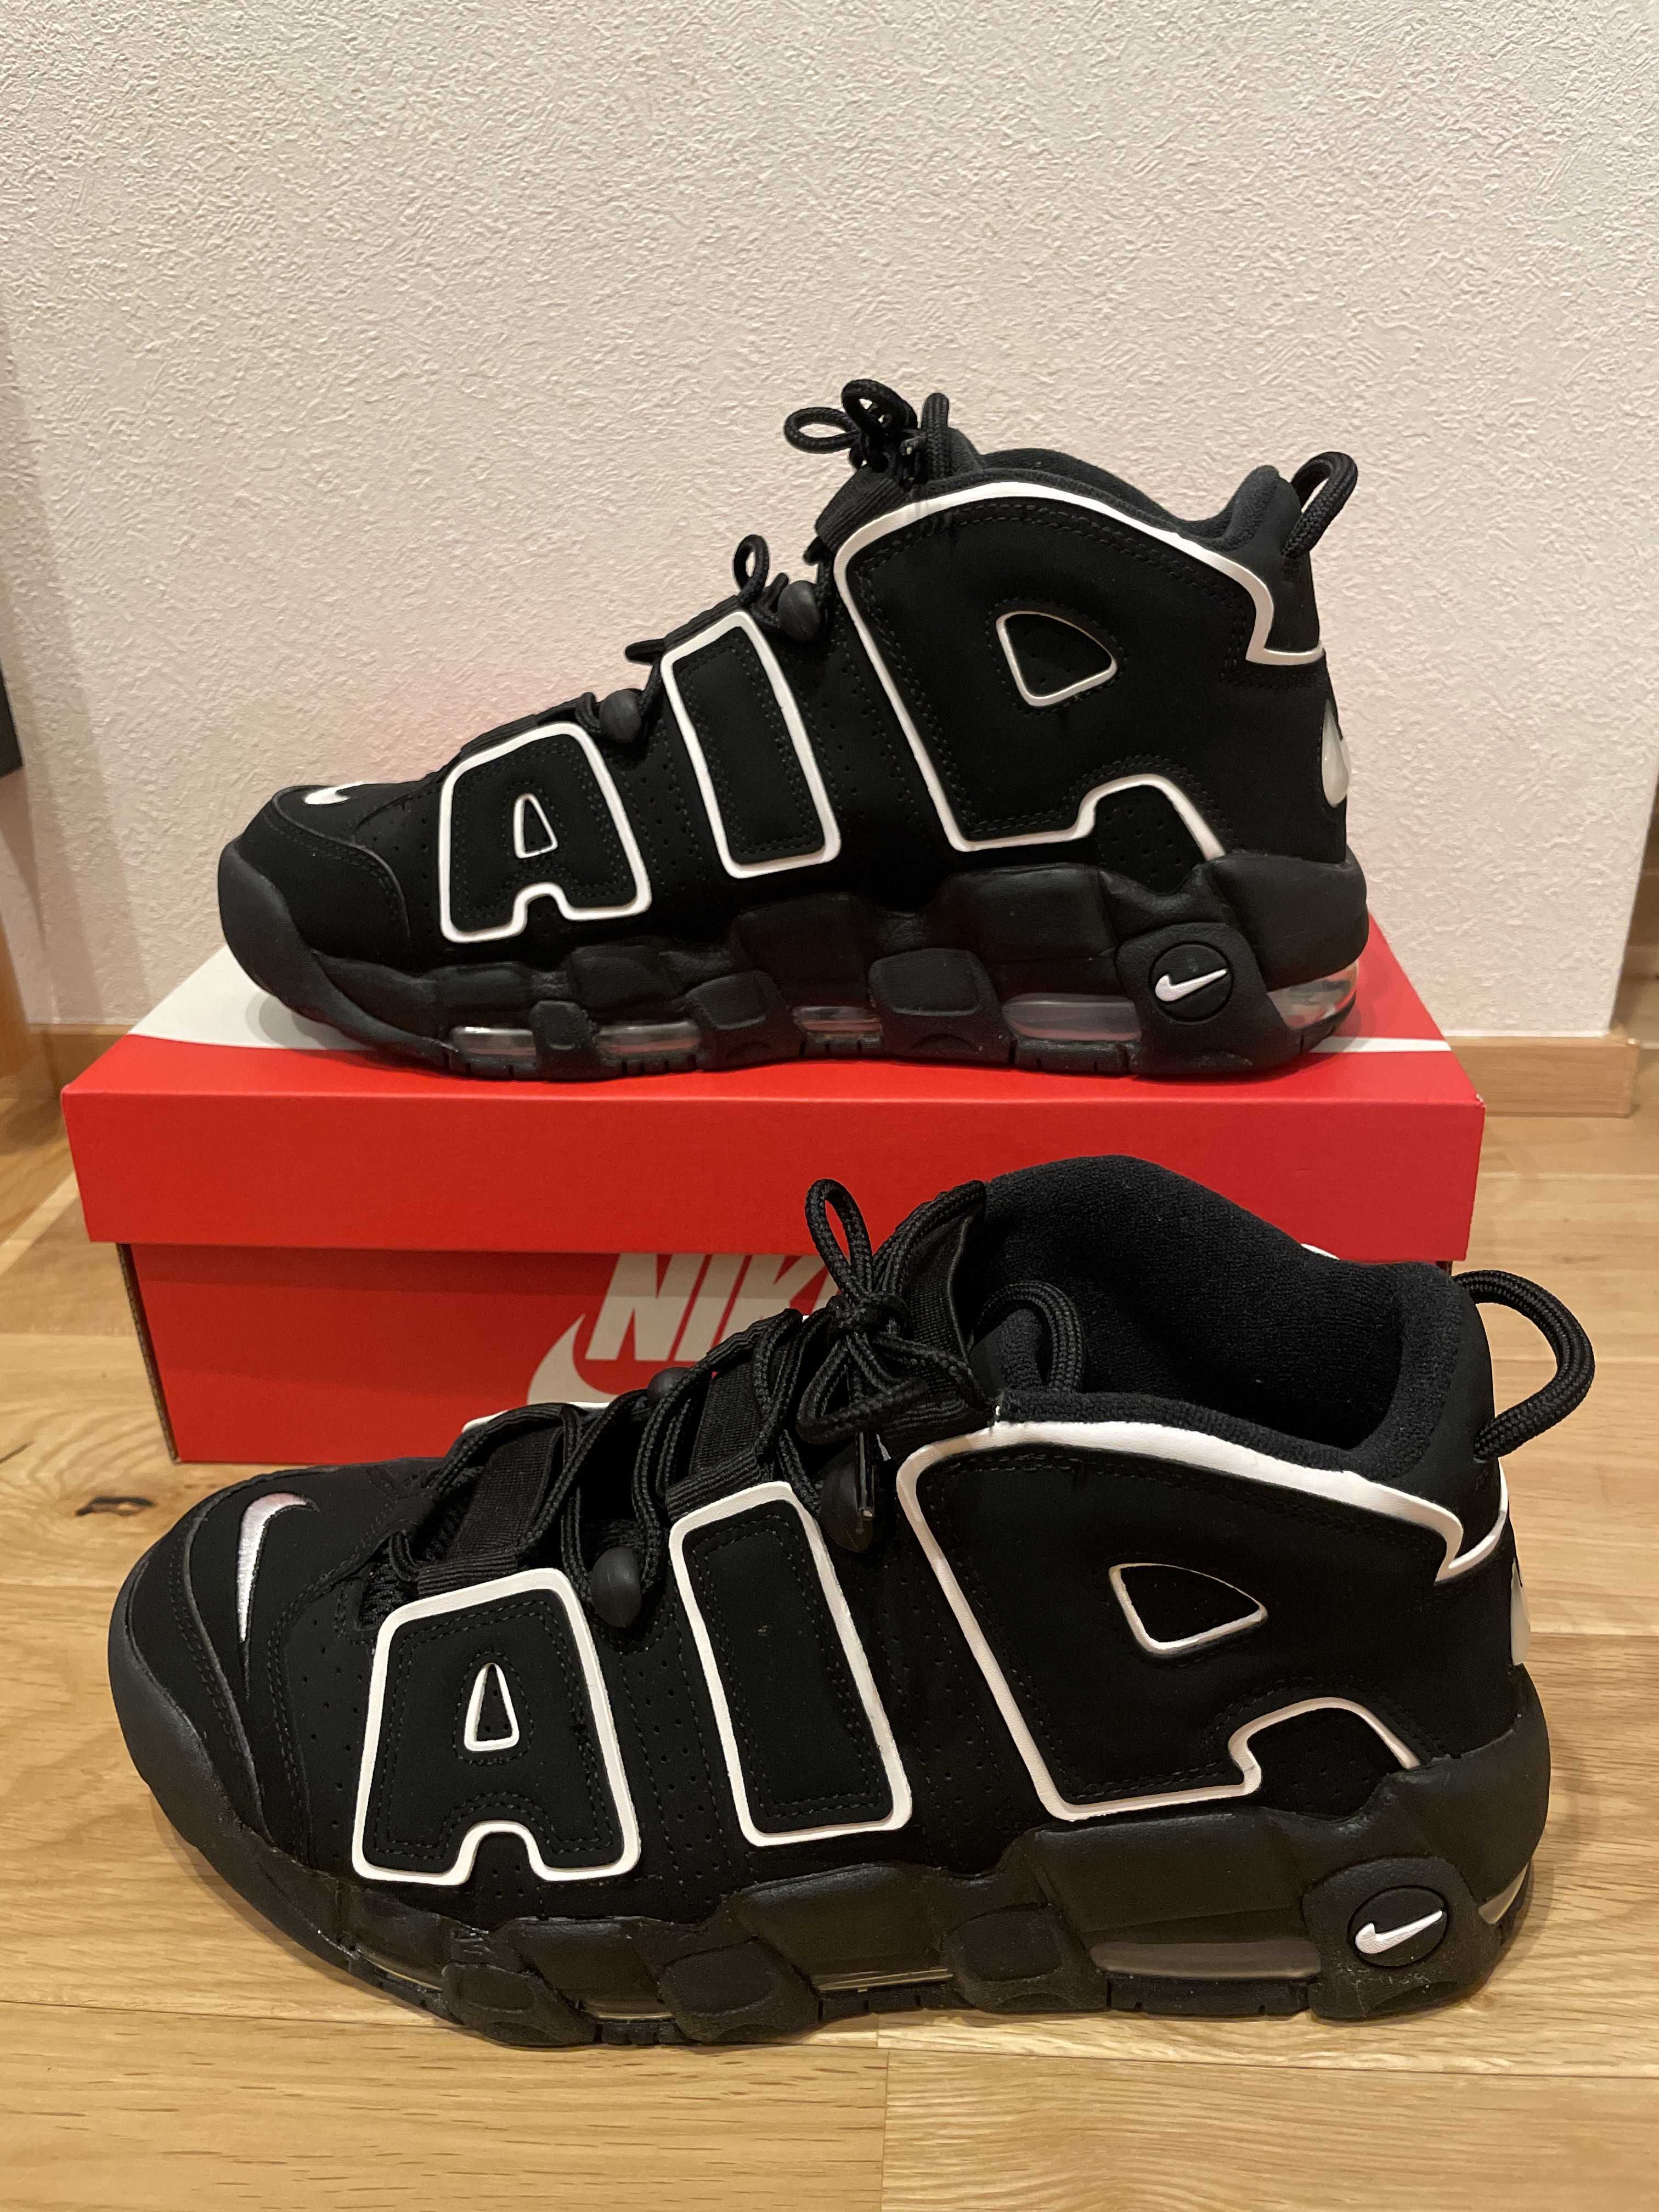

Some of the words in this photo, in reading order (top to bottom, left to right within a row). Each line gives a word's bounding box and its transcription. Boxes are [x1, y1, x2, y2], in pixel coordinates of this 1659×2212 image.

[438, 479, 1324, 944] AIR
[585, 1252, 839, 1363] NIK
[352, 1418, 1508, 1886] AIR
